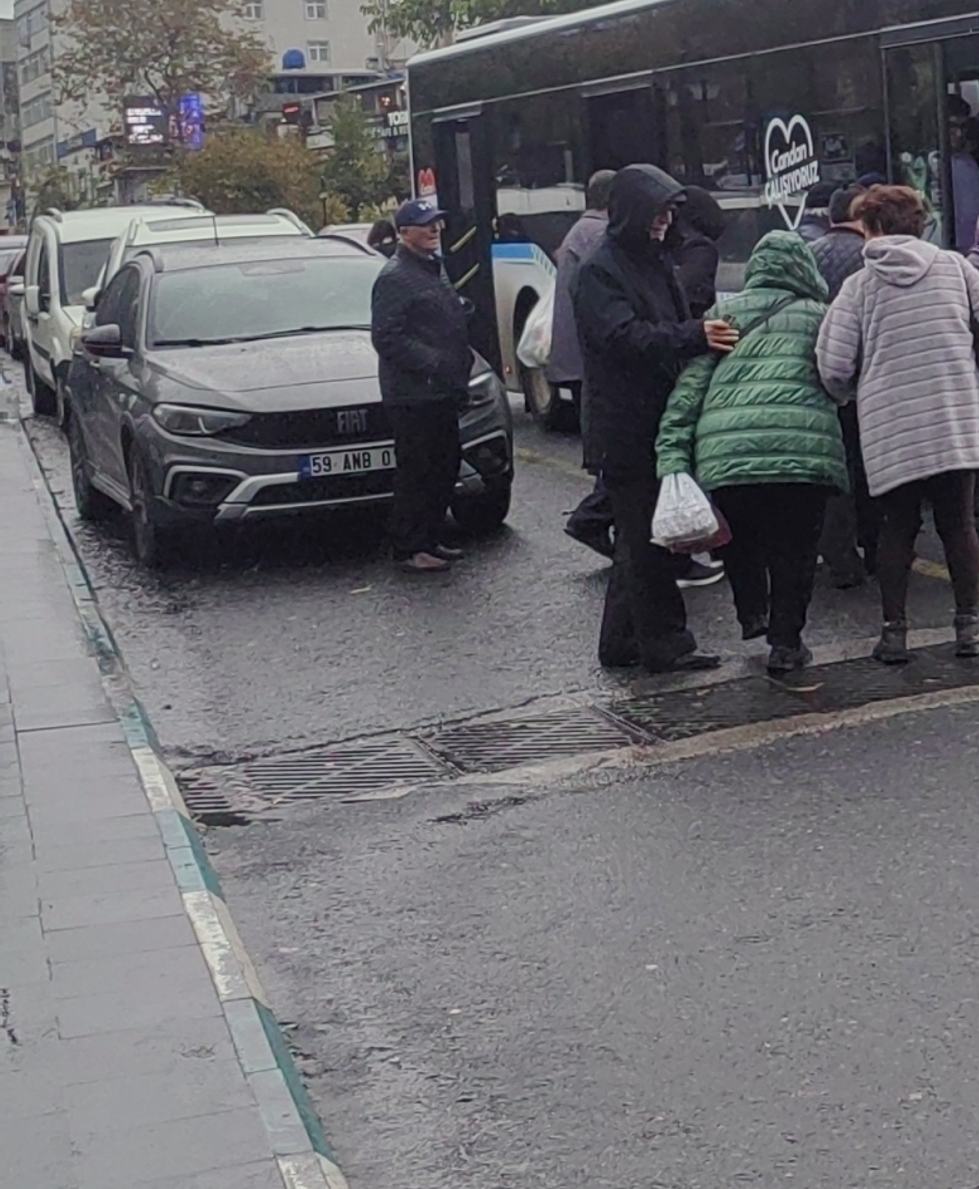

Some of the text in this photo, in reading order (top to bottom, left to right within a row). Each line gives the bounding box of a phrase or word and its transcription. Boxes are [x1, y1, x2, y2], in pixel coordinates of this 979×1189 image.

[771, 141, 807, 173] Candan
[765, 161, 819, 209] ÇALIŞIYORUZ
[337, 409, 368, 433] FIAT
[312, 456, 332, 473] 59
[343, 452, 371, 470] ANB
